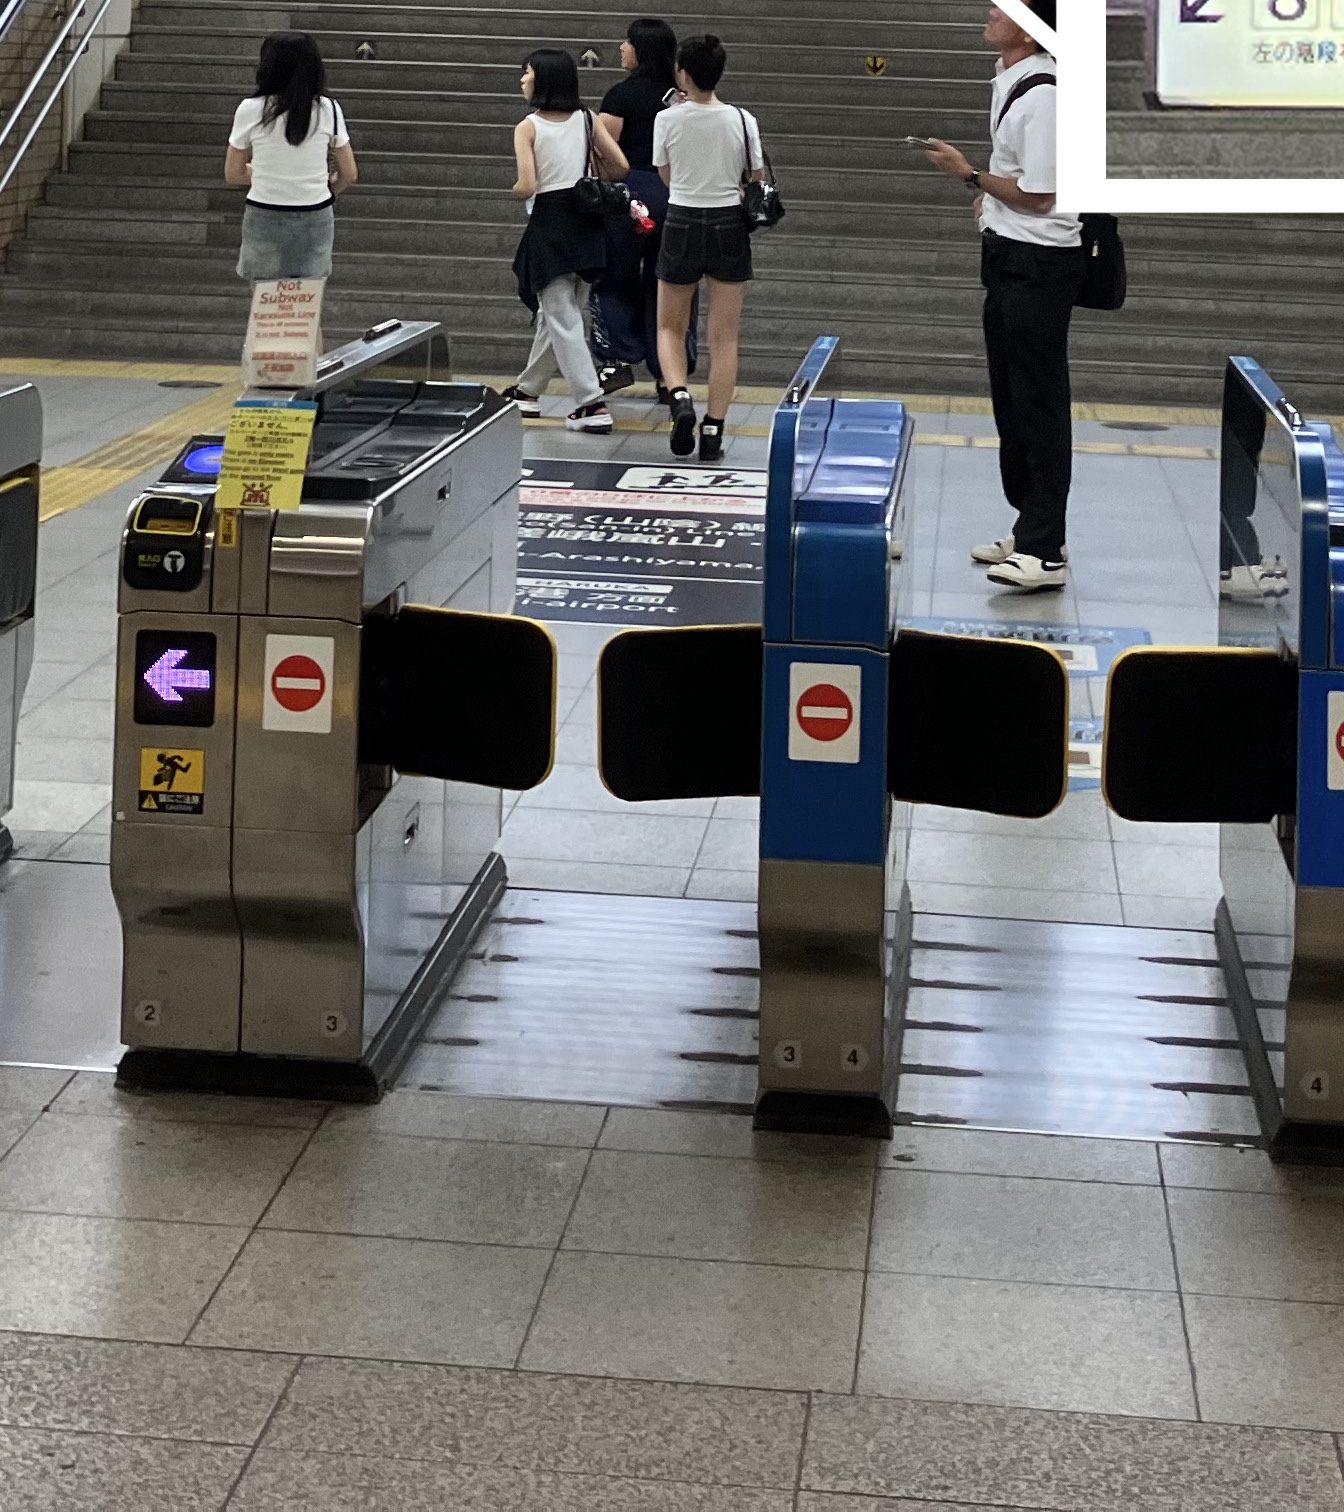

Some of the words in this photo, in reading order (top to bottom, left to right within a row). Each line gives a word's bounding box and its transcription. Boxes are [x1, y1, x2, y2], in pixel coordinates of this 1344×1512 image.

[276, 279, 303, 292] Not
[259, 291, 316, 305] Subway
[535, 579, 652, 591] HARUKA
[586, 592, 667, 605] 方面
[144, 1004, 156, 1021] 2
[326, 1015, 338, 1032] 3
[783, 1046, 796, 1062] 3
[846, 1048, 859, 1066] 4
[1310, 1076, 1323, 1094] 4
